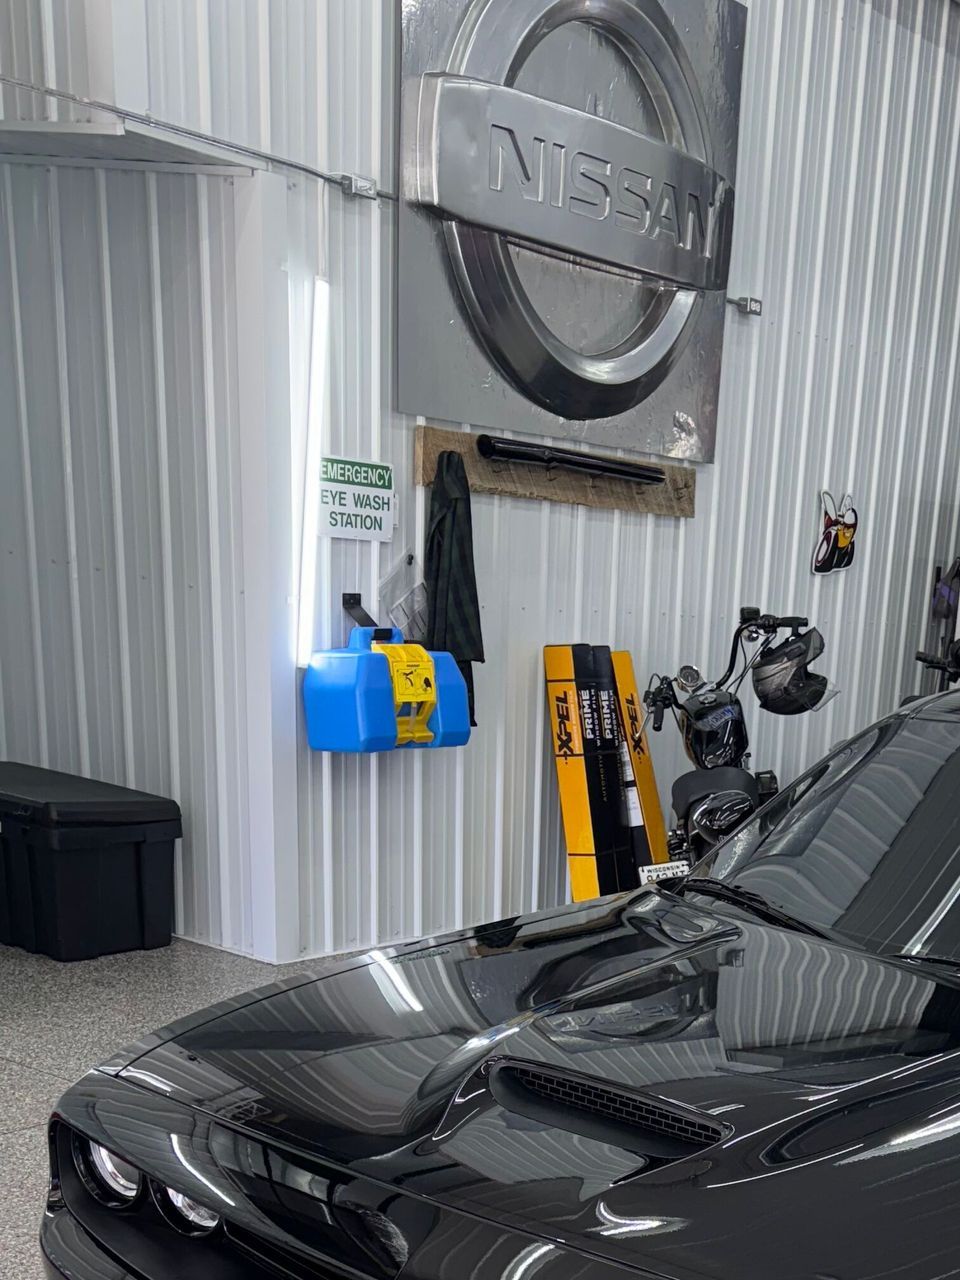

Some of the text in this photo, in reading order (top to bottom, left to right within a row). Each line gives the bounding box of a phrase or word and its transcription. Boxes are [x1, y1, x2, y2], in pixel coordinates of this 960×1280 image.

[488, 123, 724, 260] NISSAN
[320, 461, 391, 487] EMERGENCY
[320, 489, 390, 512] EYE WASH
[329, 510, 383, 532] STATION
[555, 690, 574, 755] XPEL
[581, 689, 595, 740] PRIME
[590, 689, 601, 747] WINDOW FILM
[600, 690, 613, 740] PRIME
[610, 712, 619, 747] WINDOW
[624, 692, 646, 757] XPEL
[646, 864, 680, 874] WISCONSIN
